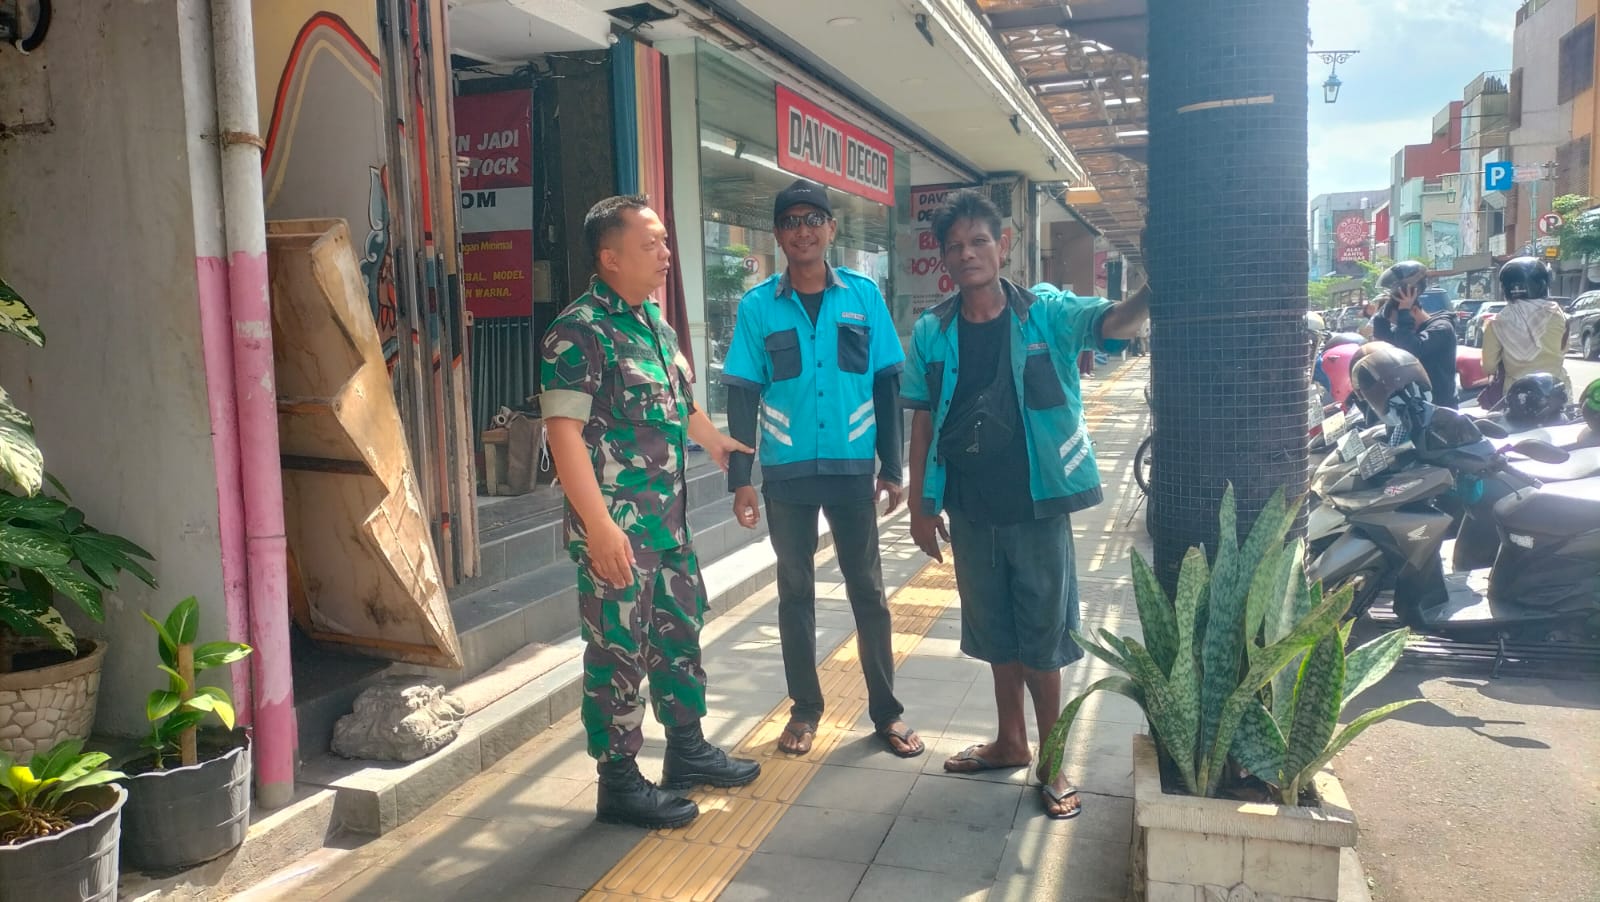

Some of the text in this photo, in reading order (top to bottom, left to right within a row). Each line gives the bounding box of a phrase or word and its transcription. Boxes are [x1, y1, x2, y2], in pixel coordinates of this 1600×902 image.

[477, 130, 519, 150] JADI
[789, 106, 888, 193] DAVIN DECOR
[1491, 166, 1505, 187] P
[481, 240, 513, 252] Minimal
[493, 270, 525, 281] MODEL
